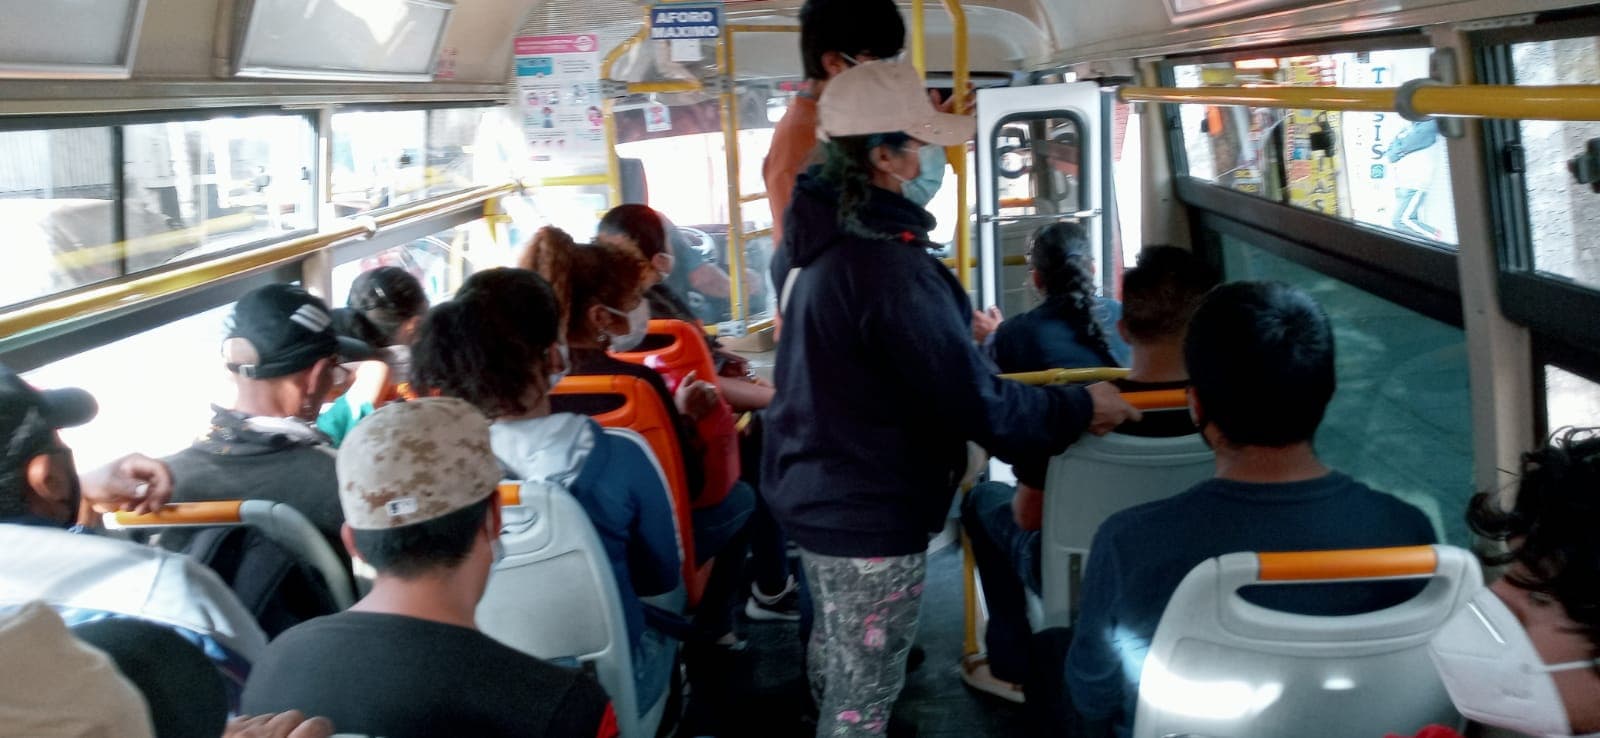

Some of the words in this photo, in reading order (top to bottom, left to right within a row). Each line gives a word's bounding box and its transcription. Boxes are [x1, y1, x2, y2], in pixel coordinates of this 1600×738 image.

[656, 11, 713, 23] AFORO
[651, 26, 719, 37] MAXIMO
[1371, 66, 1387, 160] TSIS
